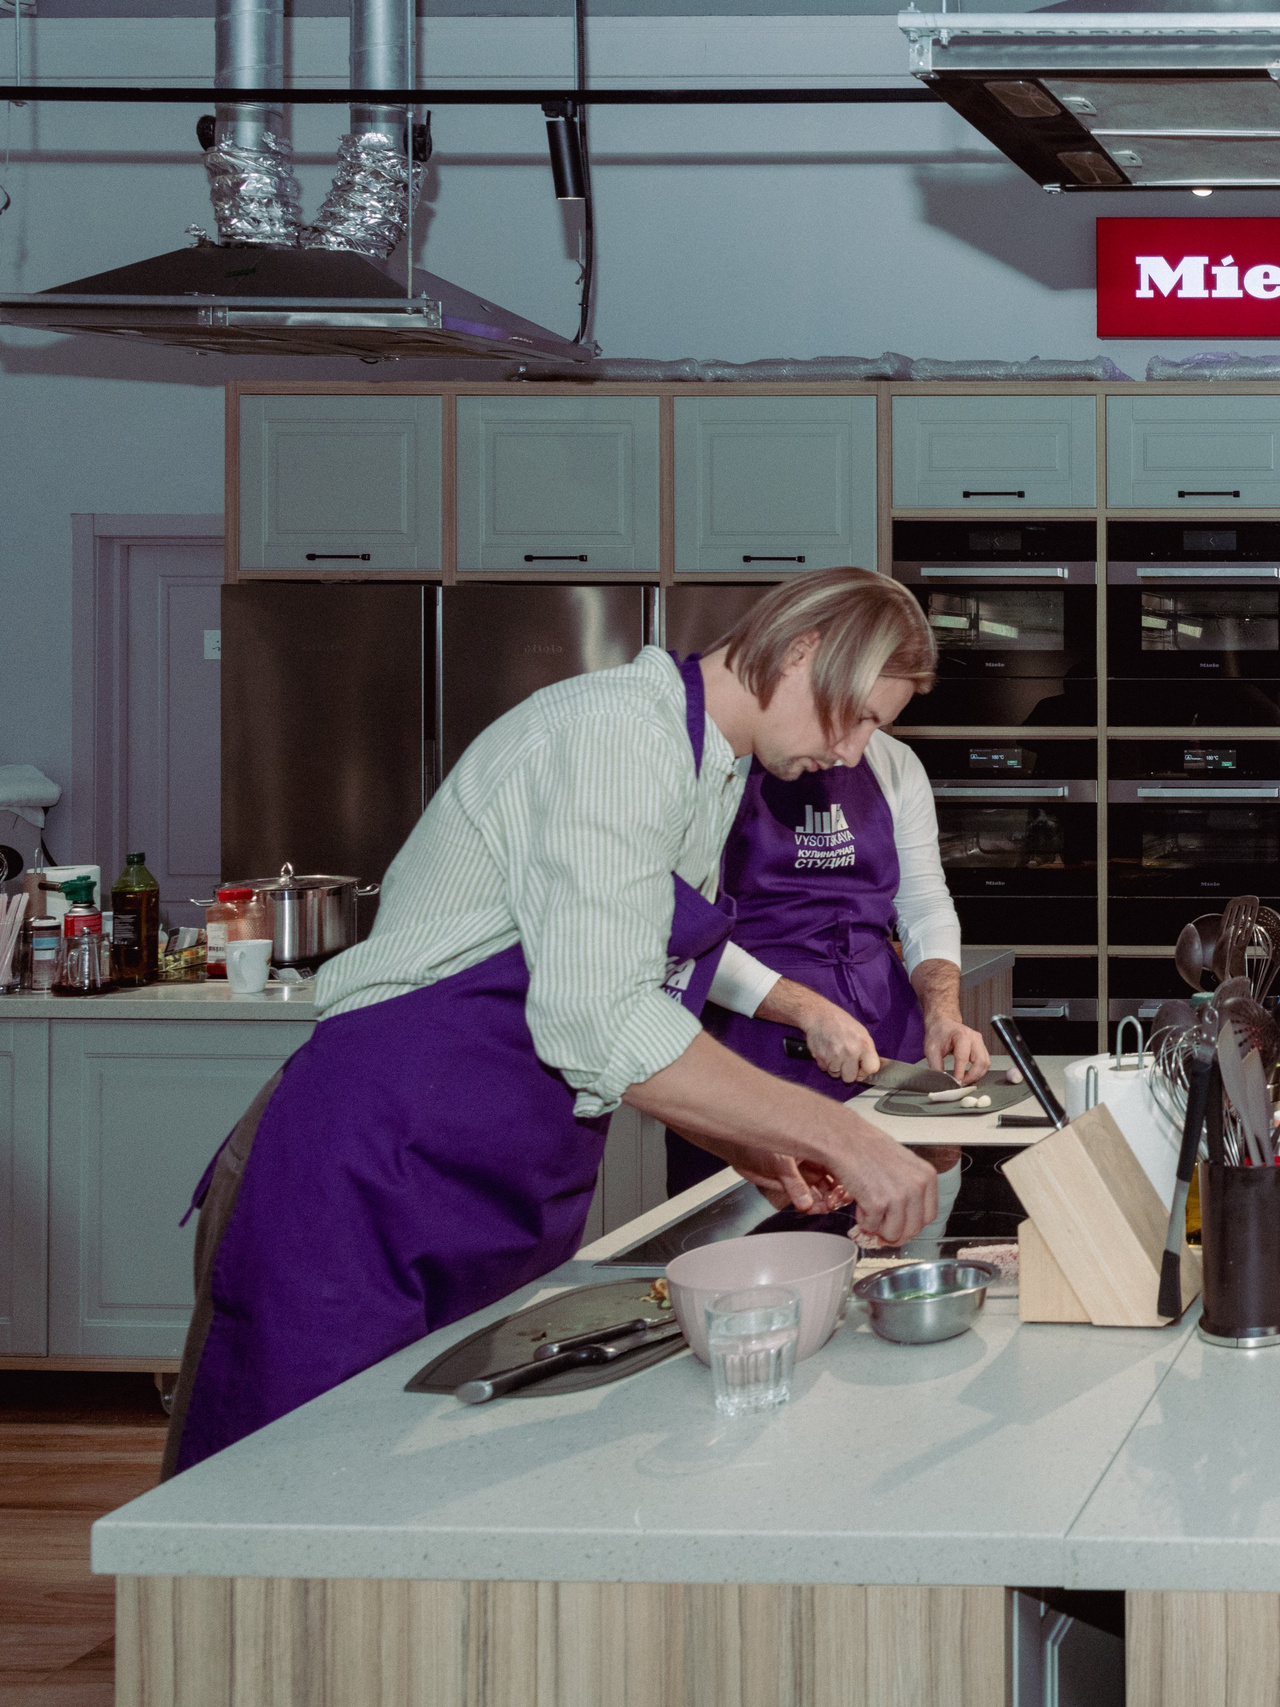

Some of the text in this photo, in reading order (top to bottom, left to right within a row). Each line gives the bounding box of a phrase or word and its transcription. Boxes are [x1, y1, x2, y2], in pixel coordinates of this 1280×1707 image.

[794, 830, 855, 847] VYSOTSKAYA
[798, 845, 855, 858] КУЛИНАРНАЯ
[794, 854, 855, 869] СТУДИЯ
